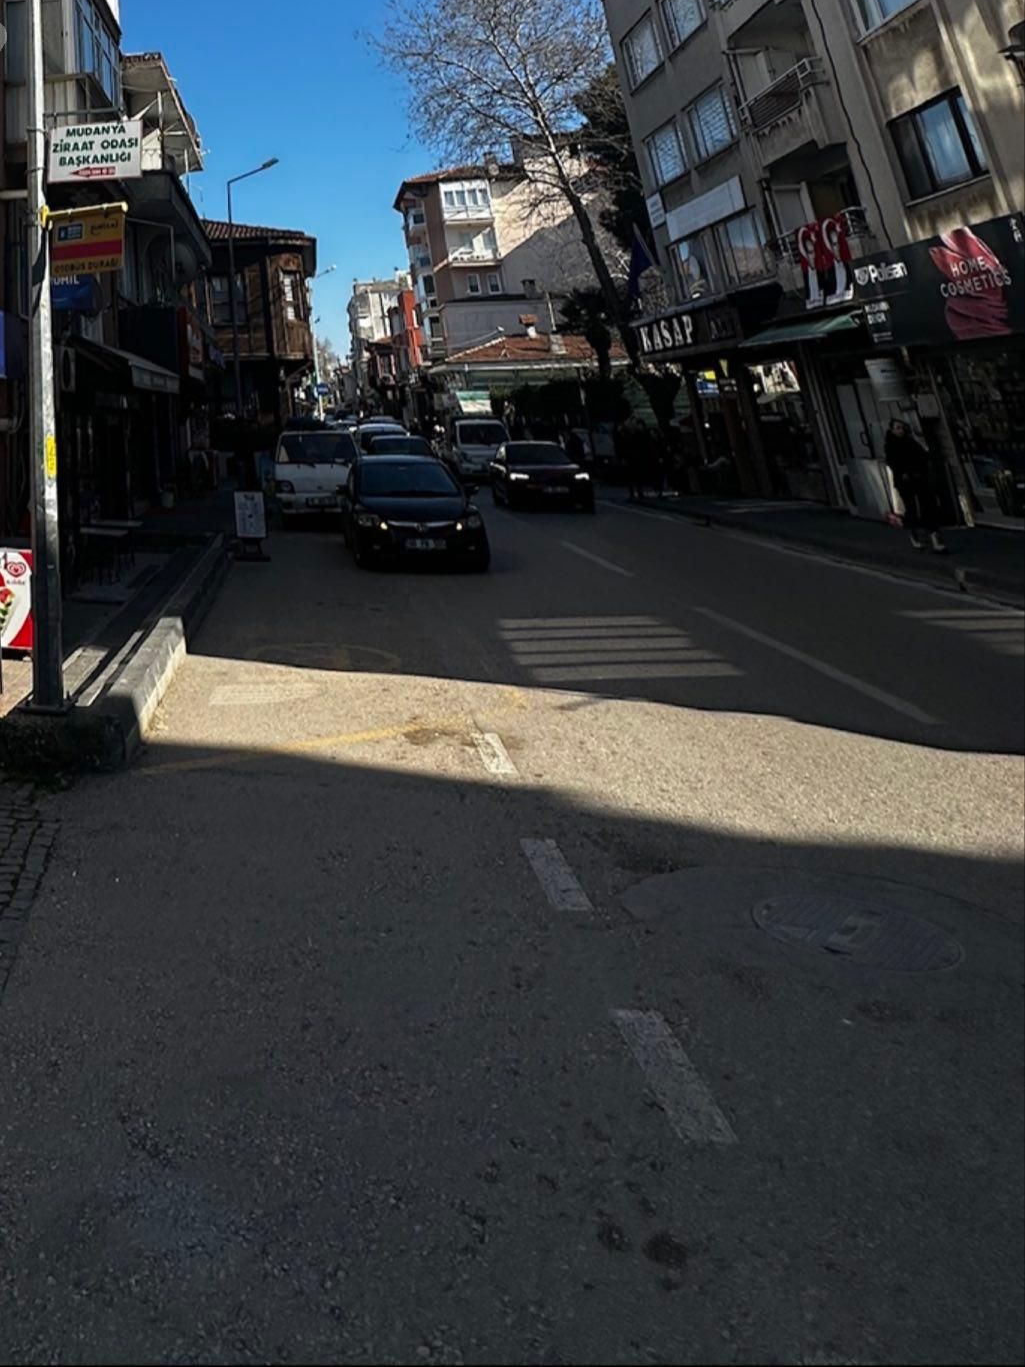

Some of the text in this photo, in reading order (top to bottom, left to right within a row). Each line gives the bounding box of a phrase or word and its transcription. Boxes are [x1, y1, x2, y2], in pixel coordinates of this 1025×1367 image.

[66, 125, 126, 137] MUDANYA
[52, 137, 138, 153] ZİRAAT ODASI
[59, 152, 131, 167] BAŞKANLIĞI
[950, 256, 987, 278] HOME
[940, 269, 1012, 298] COSMETICS
[640, 315, 693, 352] KASAP
